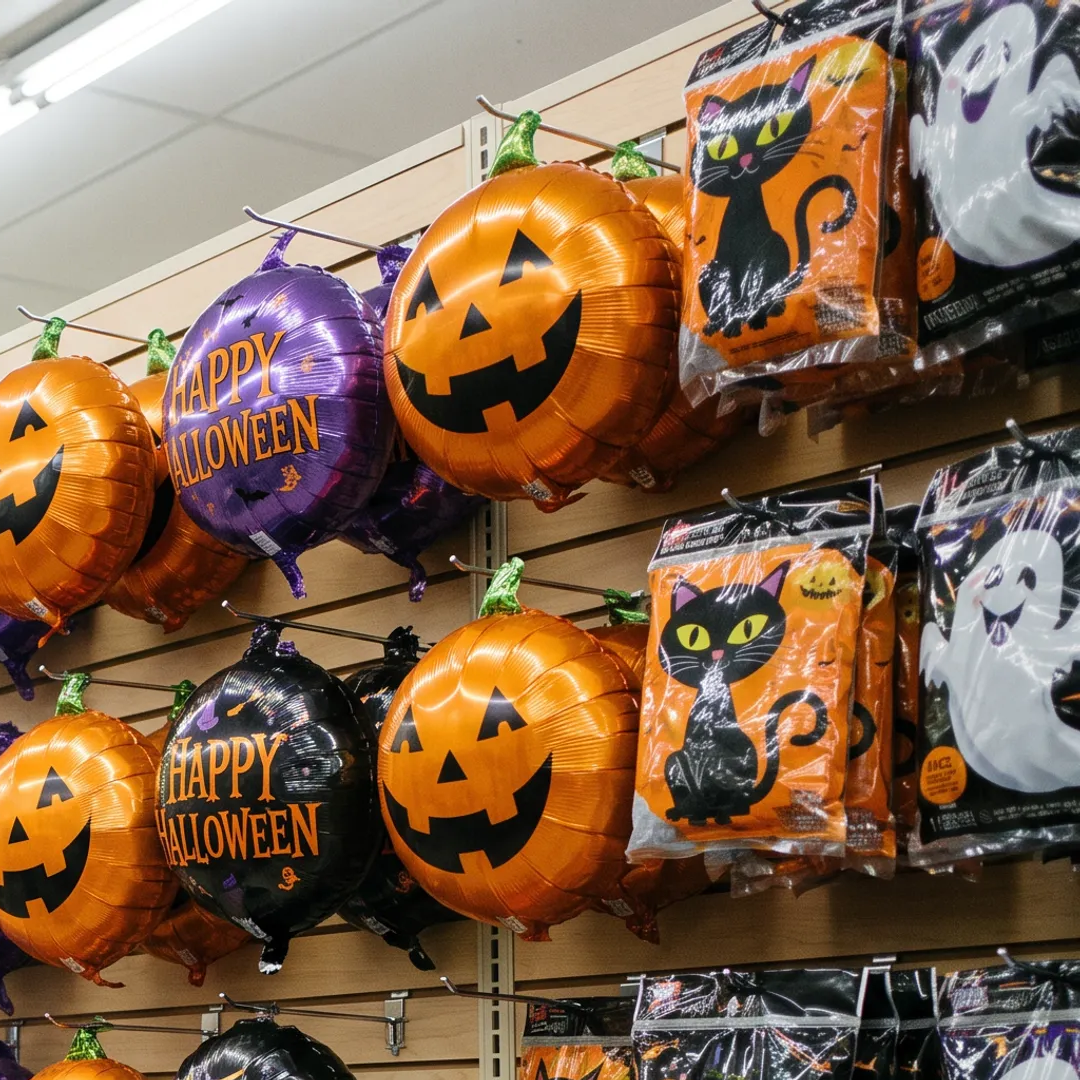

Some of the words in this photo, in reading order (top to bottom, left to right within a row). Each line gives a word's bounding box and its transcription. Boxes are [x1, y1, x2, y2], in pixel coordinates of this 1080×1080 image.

[169, 330, 287, 427] HAPPY
[166, 732, 289, 805] HAPPY
[154, 802, 321, 867] HALLOWEEN
